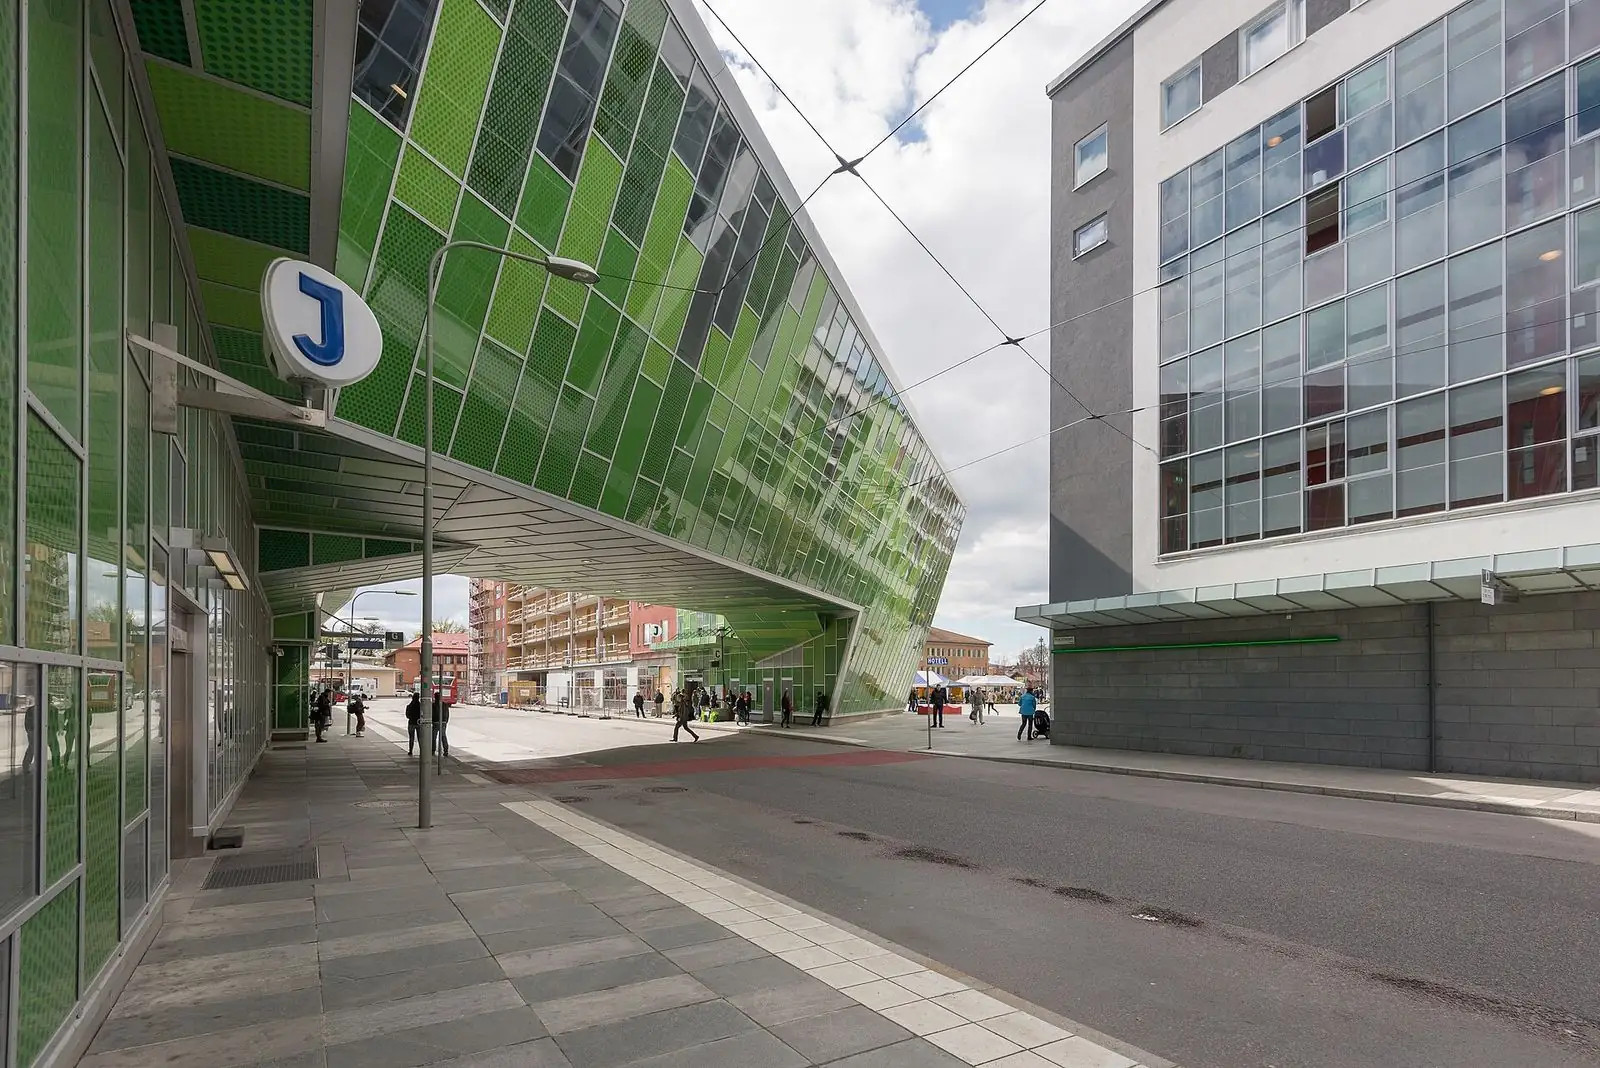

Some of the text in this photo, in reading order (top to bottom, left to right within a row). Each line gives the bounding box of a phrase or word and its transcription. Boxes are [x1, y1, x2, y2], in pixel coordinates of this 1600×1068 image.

[292, 271, 344, 366] J
[654, 626, 658, 636] J
[716, 650, 720, 658] C
